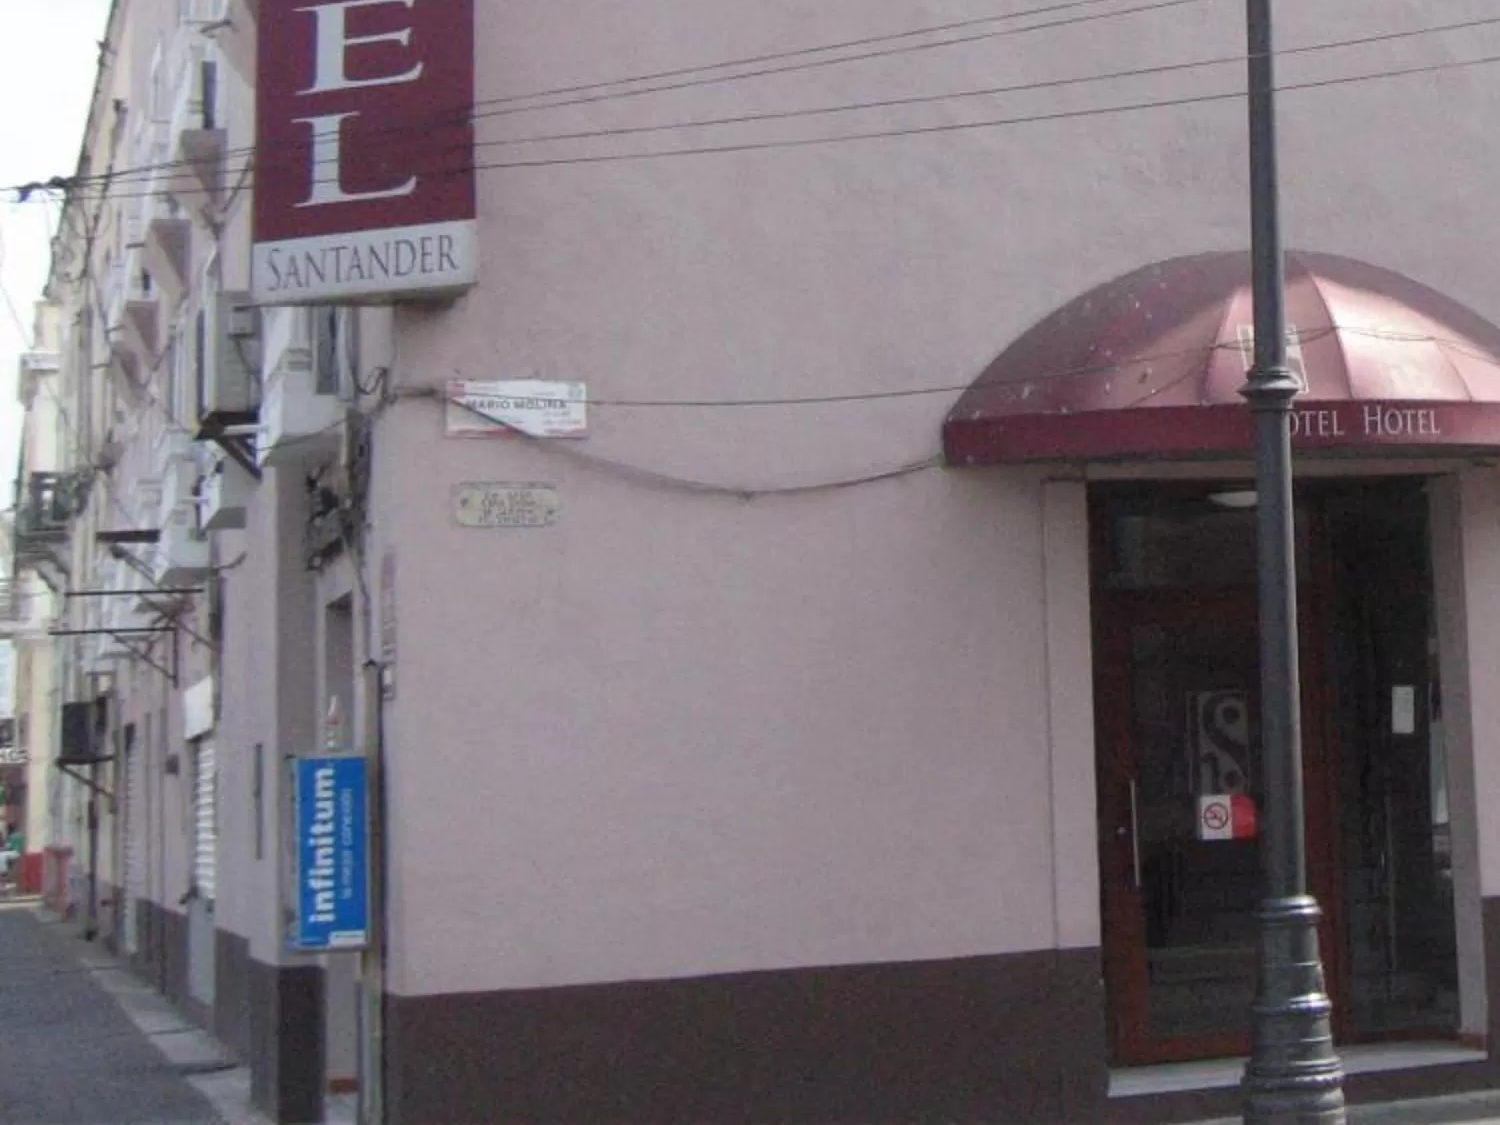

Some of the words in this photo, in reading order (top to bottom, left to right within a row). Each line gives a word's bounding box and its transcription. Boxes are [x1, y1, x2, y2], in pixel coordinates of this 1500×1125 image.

[266, 233, 460, 292] SANTANDER
[1287, 409, 1345, 437] OTEL
[308, 767, 336, 923] infinitum
